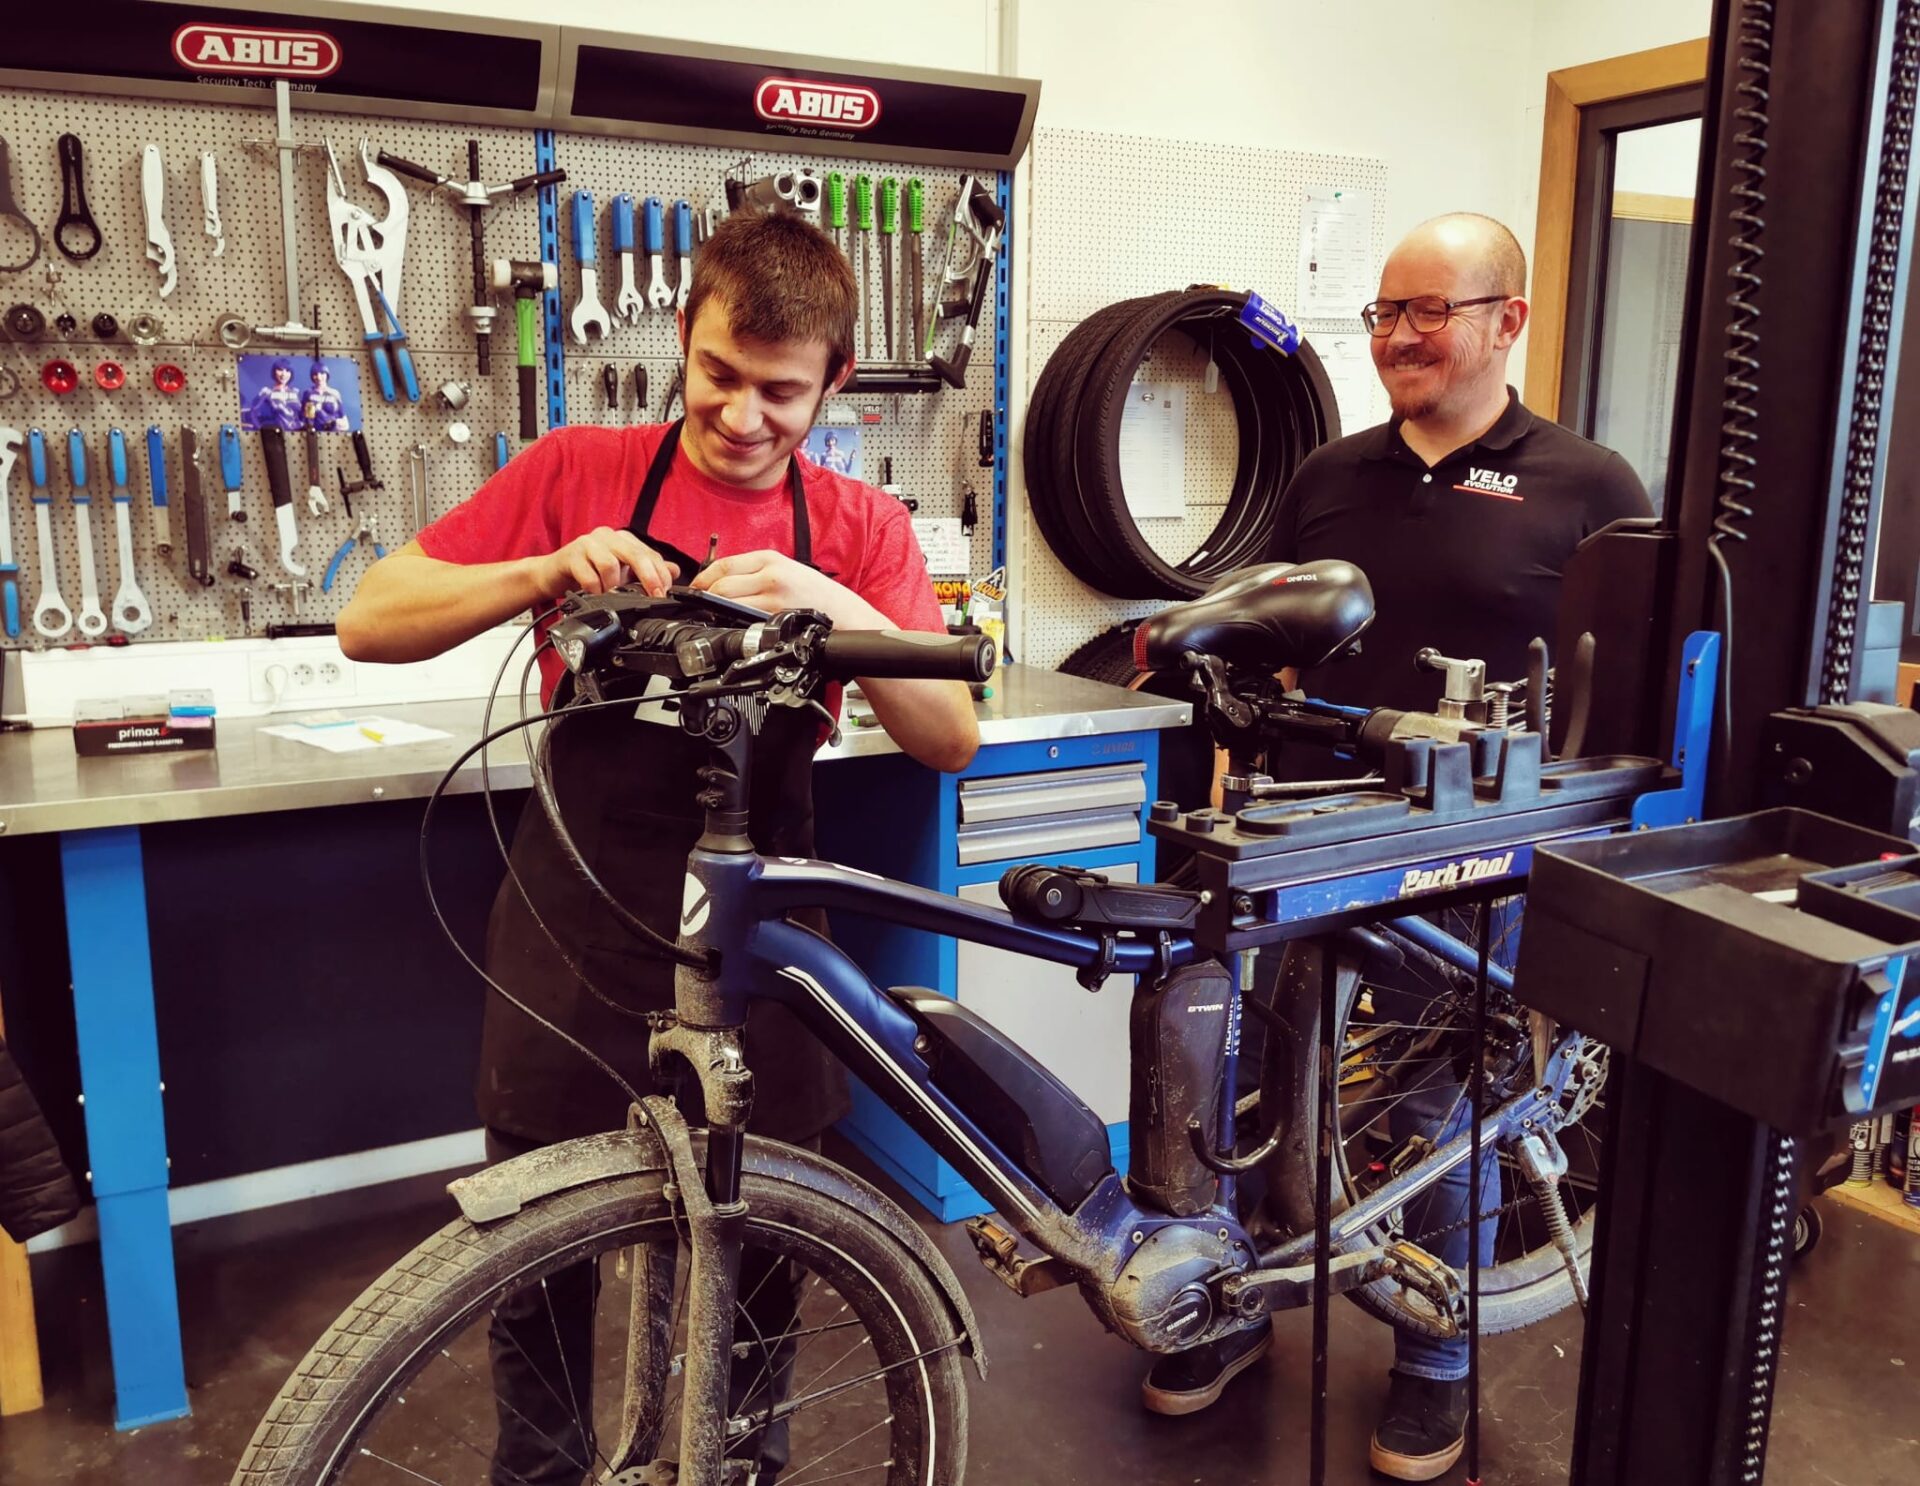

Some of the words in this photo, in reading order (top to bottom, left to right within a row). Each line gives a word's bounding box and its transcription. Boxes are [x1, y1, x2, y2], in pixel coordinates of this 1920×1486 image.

[197, 35, 319, 67] ABUS
[243, 78, 266, 89] Tech
[270, 80, 317, 94] Gmany
[771, 88, 865, 121] ABUS
[799, 126, 817, 136] Tech
[1470, 466, 1518, 488] VELO
[1463, 480, 1514, 494] EVOLUTION
[119, 727, 160, 741] primax
[1399, 862, 1460, 895] Park
[1461, 852, 1514, 882] Tool
